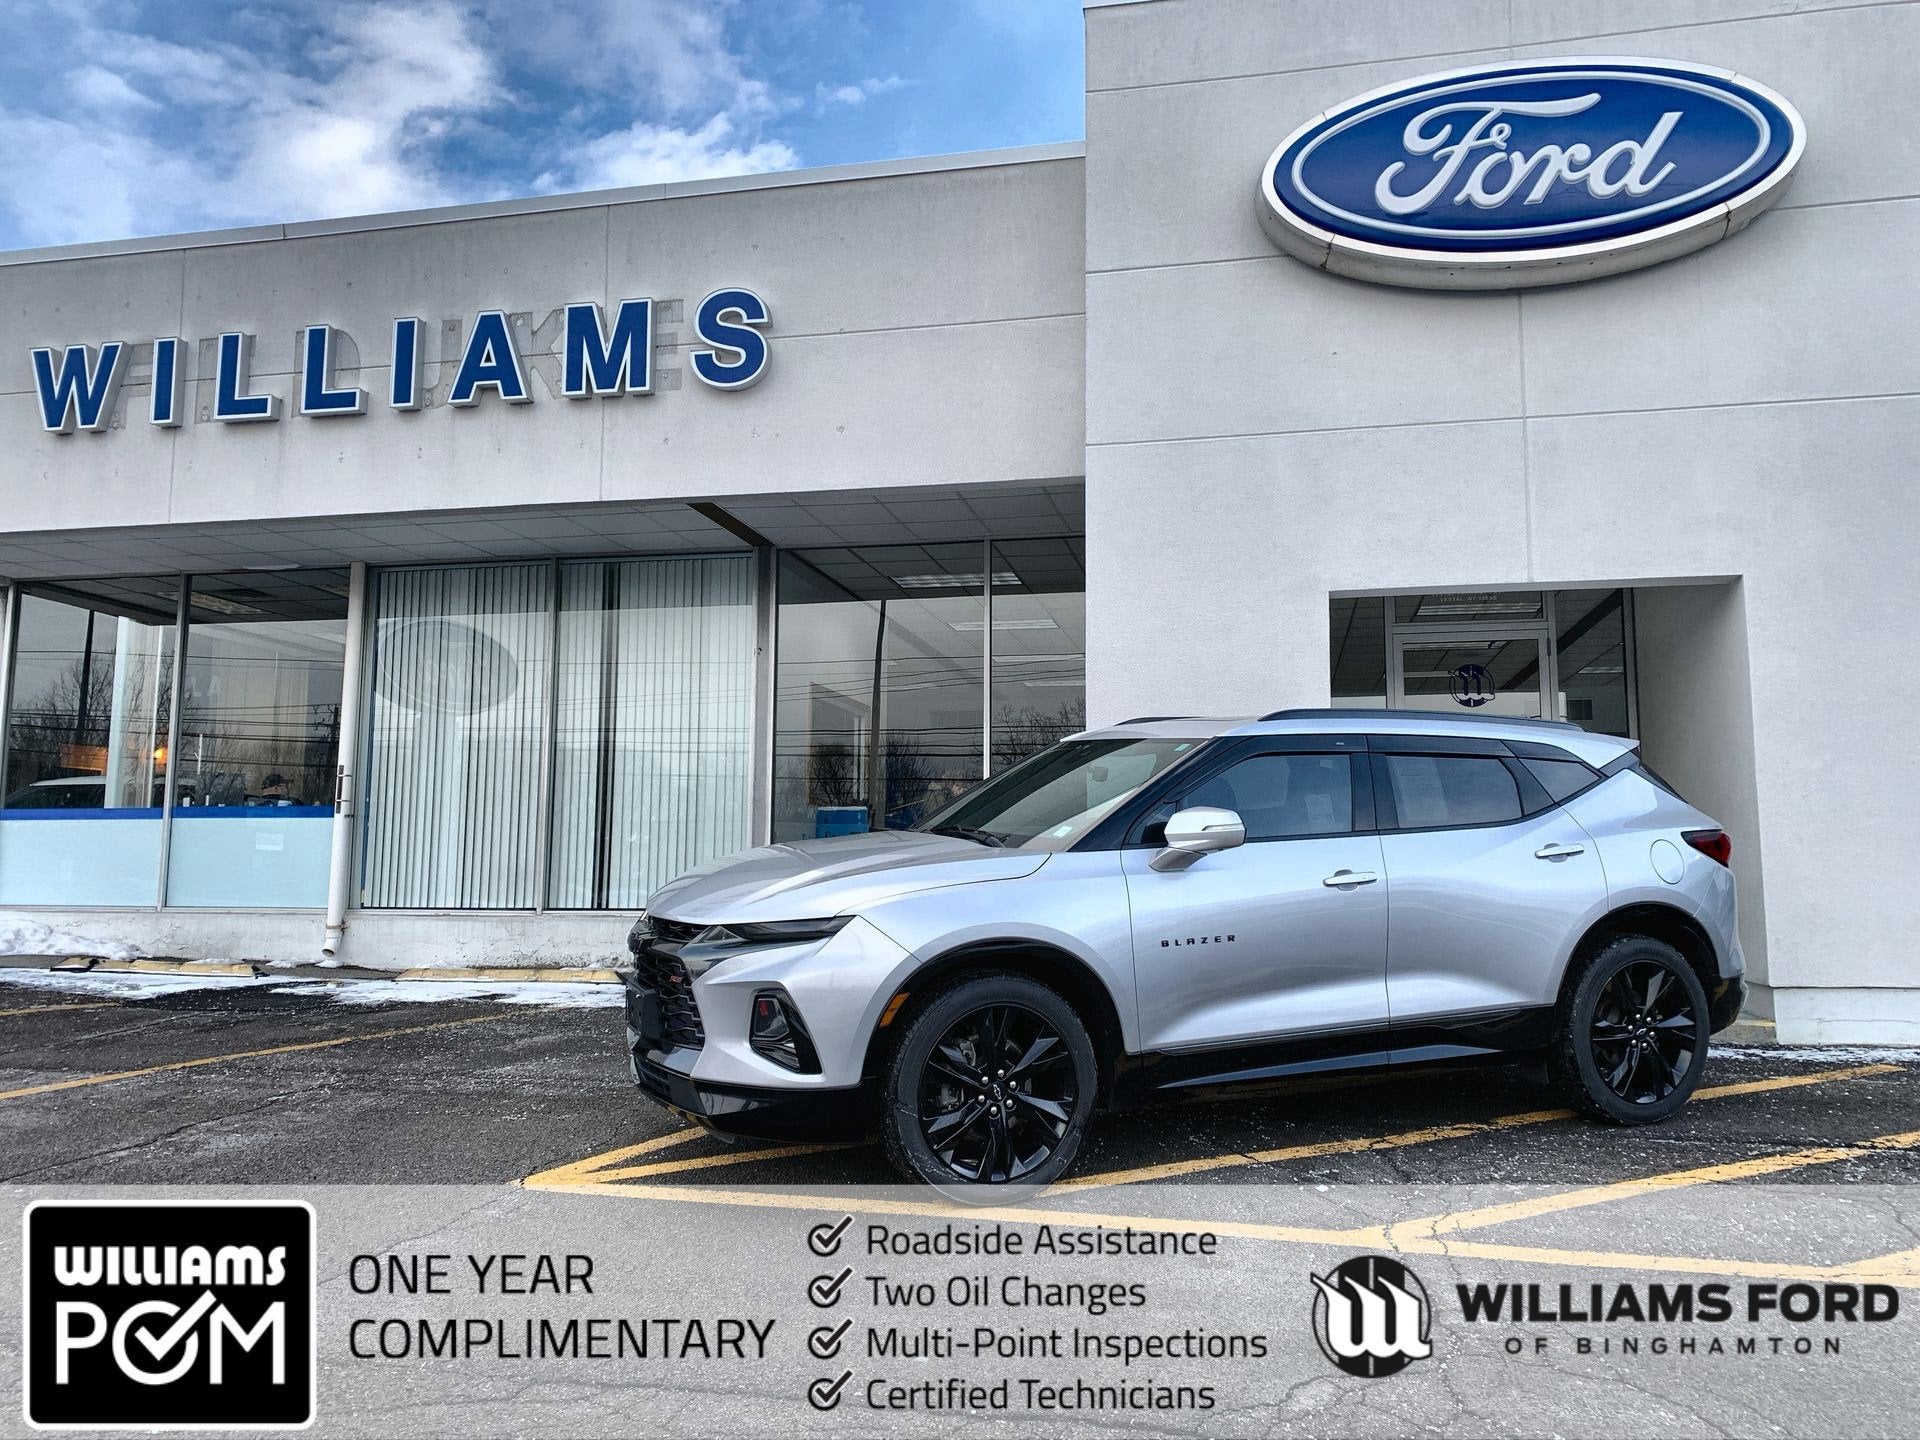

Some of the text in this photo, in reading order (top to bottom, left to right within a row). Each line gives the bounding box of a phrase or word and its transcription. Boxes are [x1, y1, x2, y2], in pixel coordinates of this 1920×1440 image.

[1375, 92, 1683, 215] Ford
[30, 287, 772, 435] WILLIAMS
[1160, 934, 1236, 948] BLAZER
